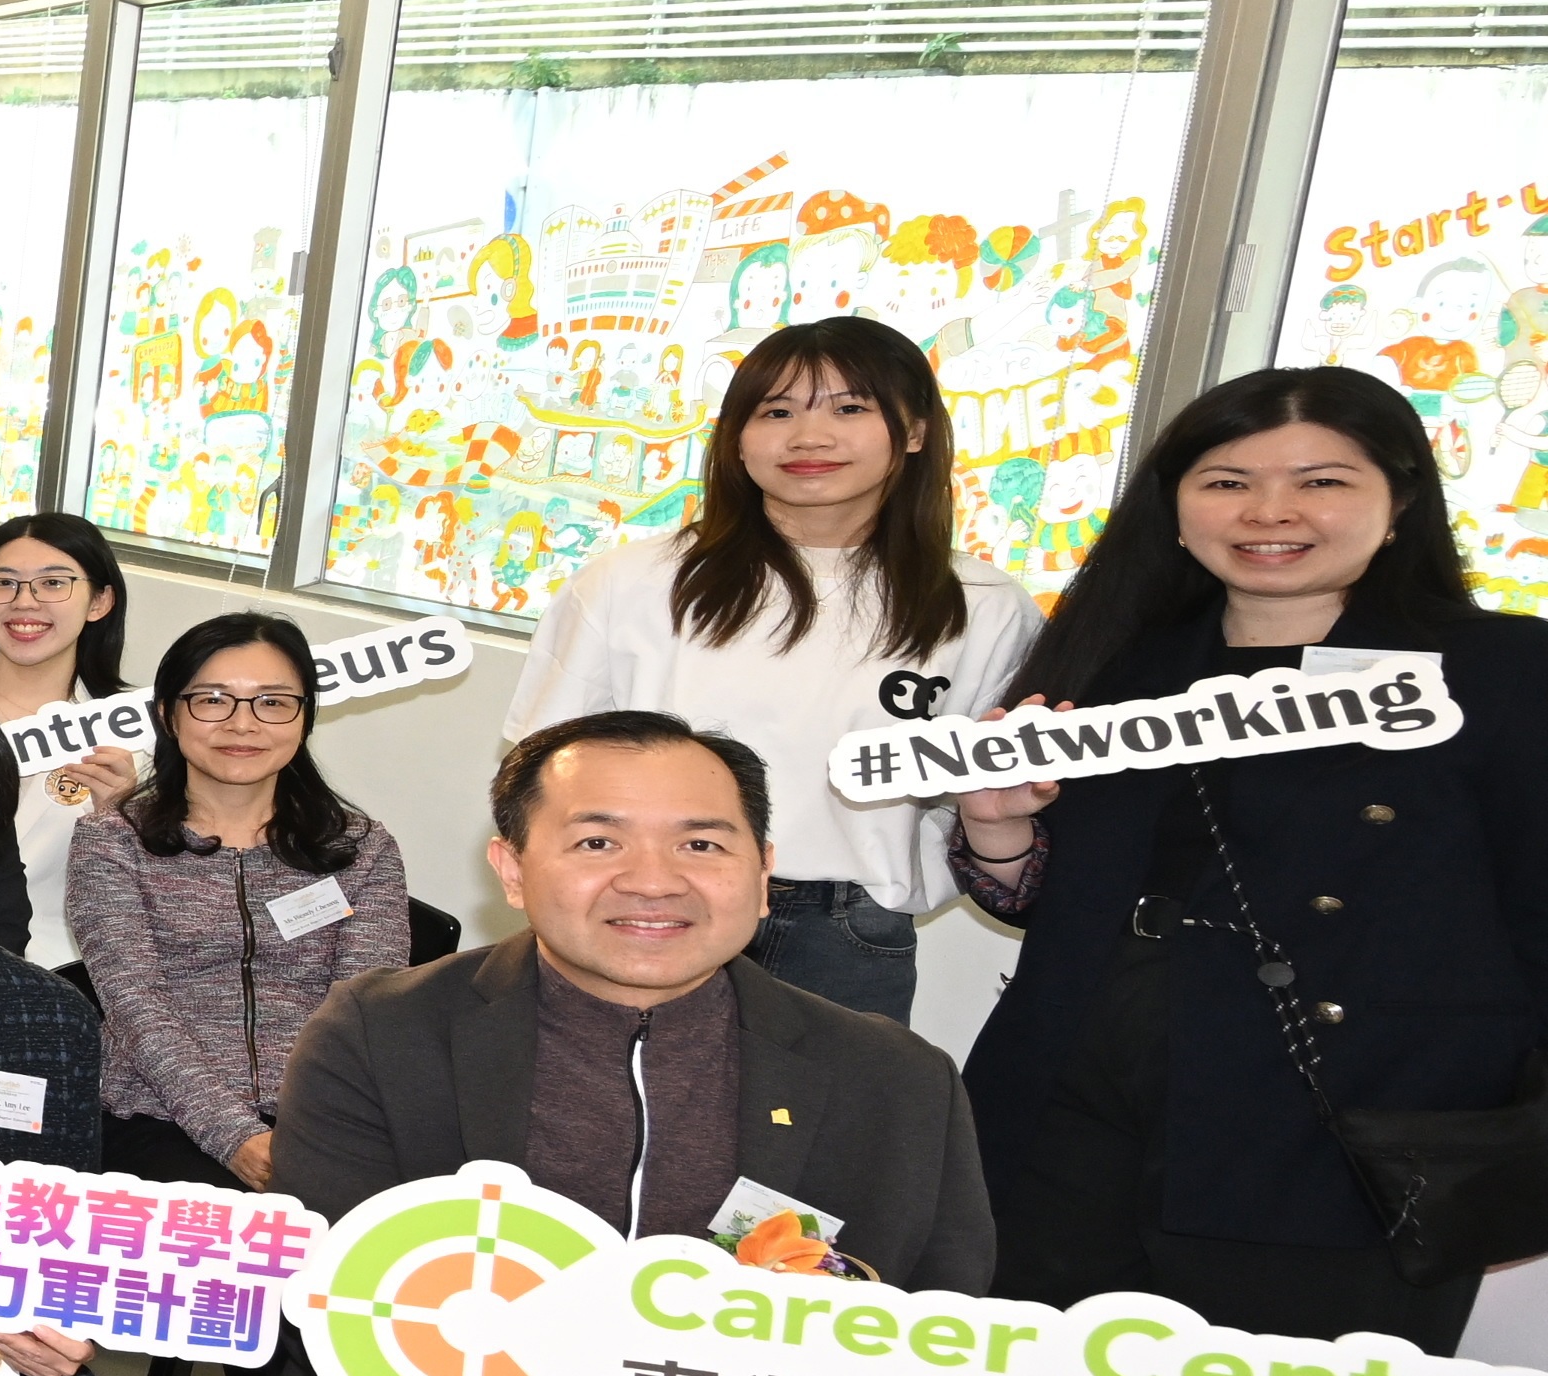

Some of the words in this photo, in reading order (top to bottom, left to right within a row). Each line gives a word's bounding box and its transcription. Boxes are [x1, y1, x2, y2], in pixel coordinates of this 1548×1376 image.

[952, 355, 1139, 462] AMERS
[12, 625, 457, 765] ntreeurs
[851, 671, 1440, 788] #Networking
[4, 1099, 17, 1111] Amy
[19, 1101, 31, 1111] Lee
[631, 1257, 1036, 1374] Career
